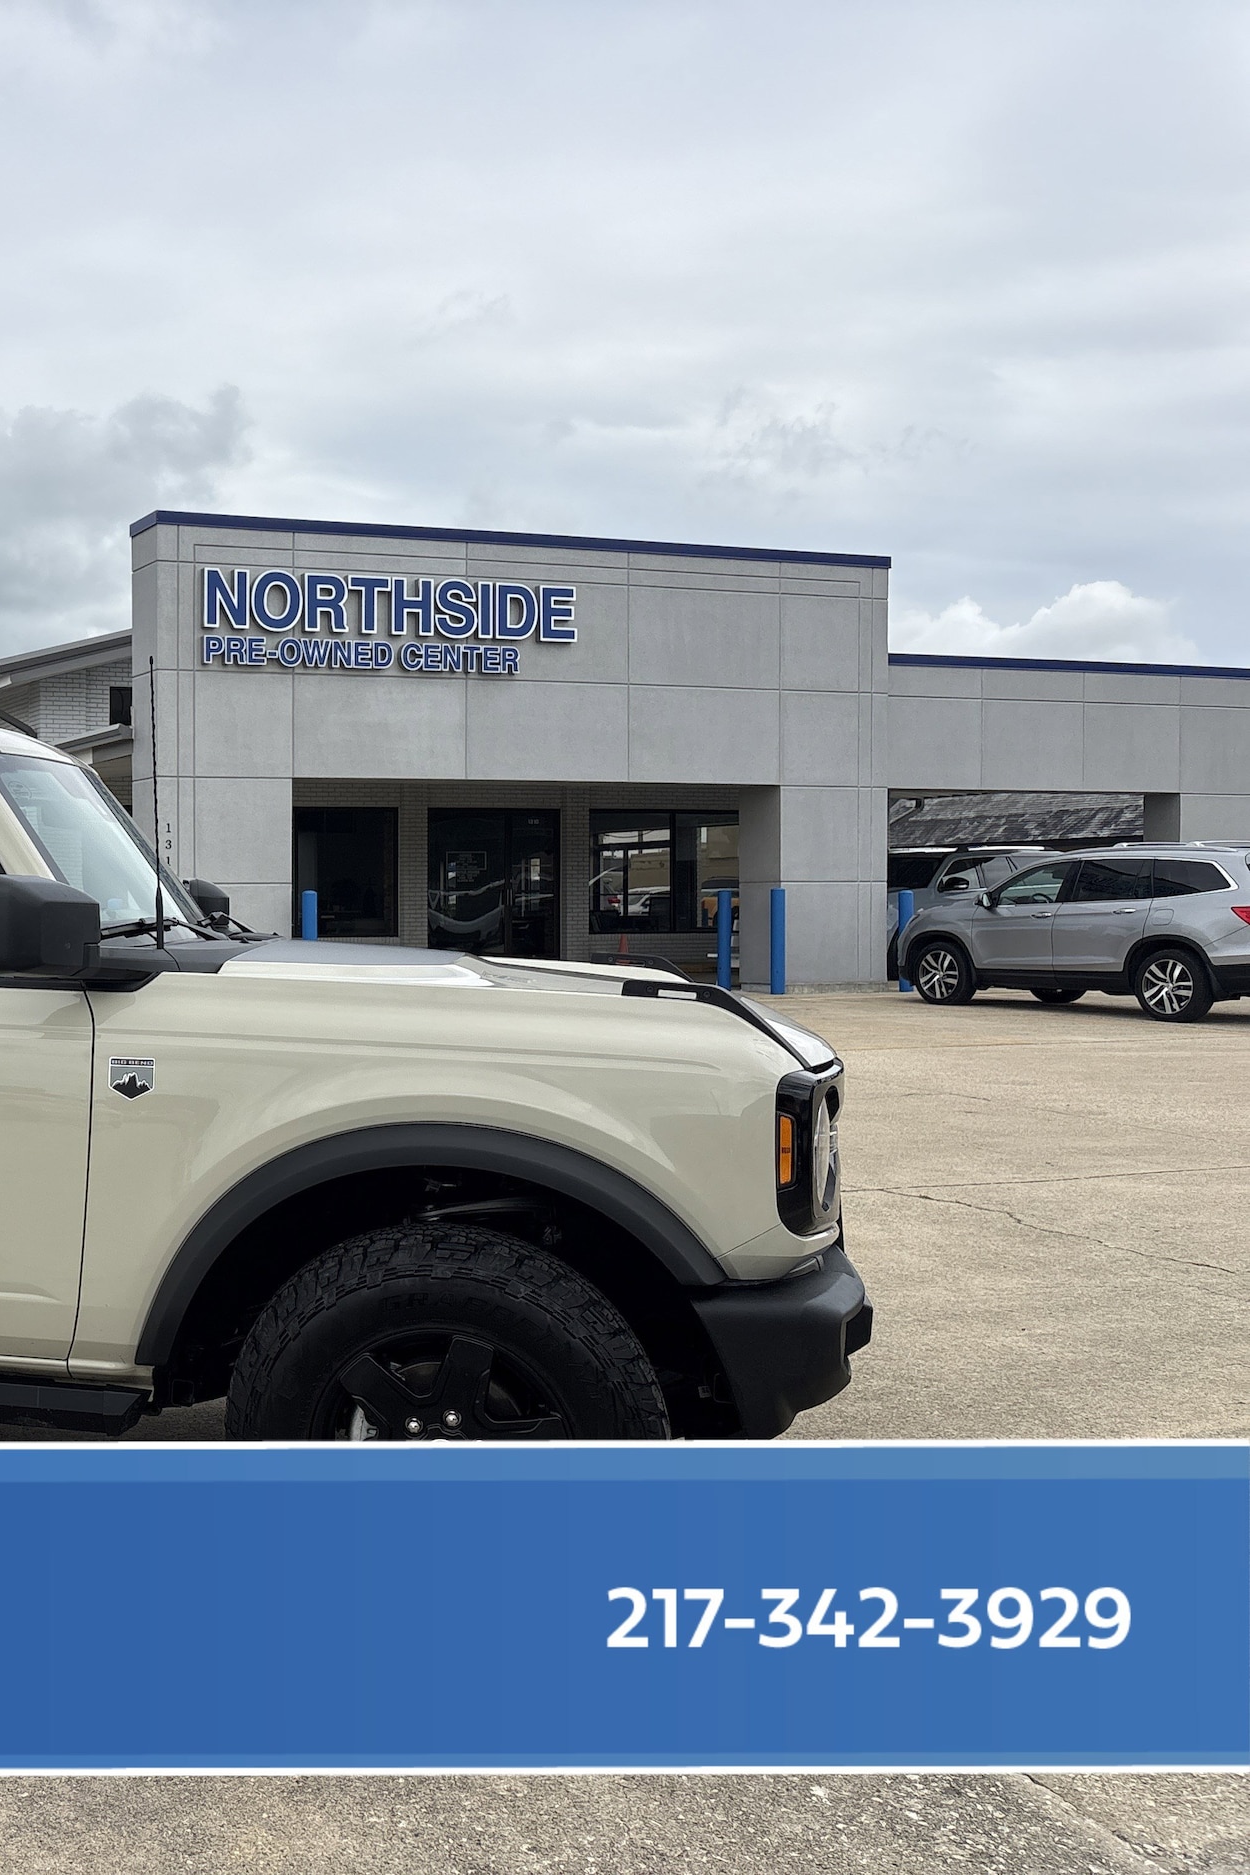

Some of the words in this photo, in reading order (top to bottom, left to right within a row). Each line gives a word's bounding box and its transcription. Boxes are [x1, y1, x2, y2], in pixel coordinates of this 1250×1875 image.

[203, 567, 578, 643] NORTHSIDE
[203, 635, 394, 670] PRE-OWNED
[401, 642, 520, 674] CENTER
